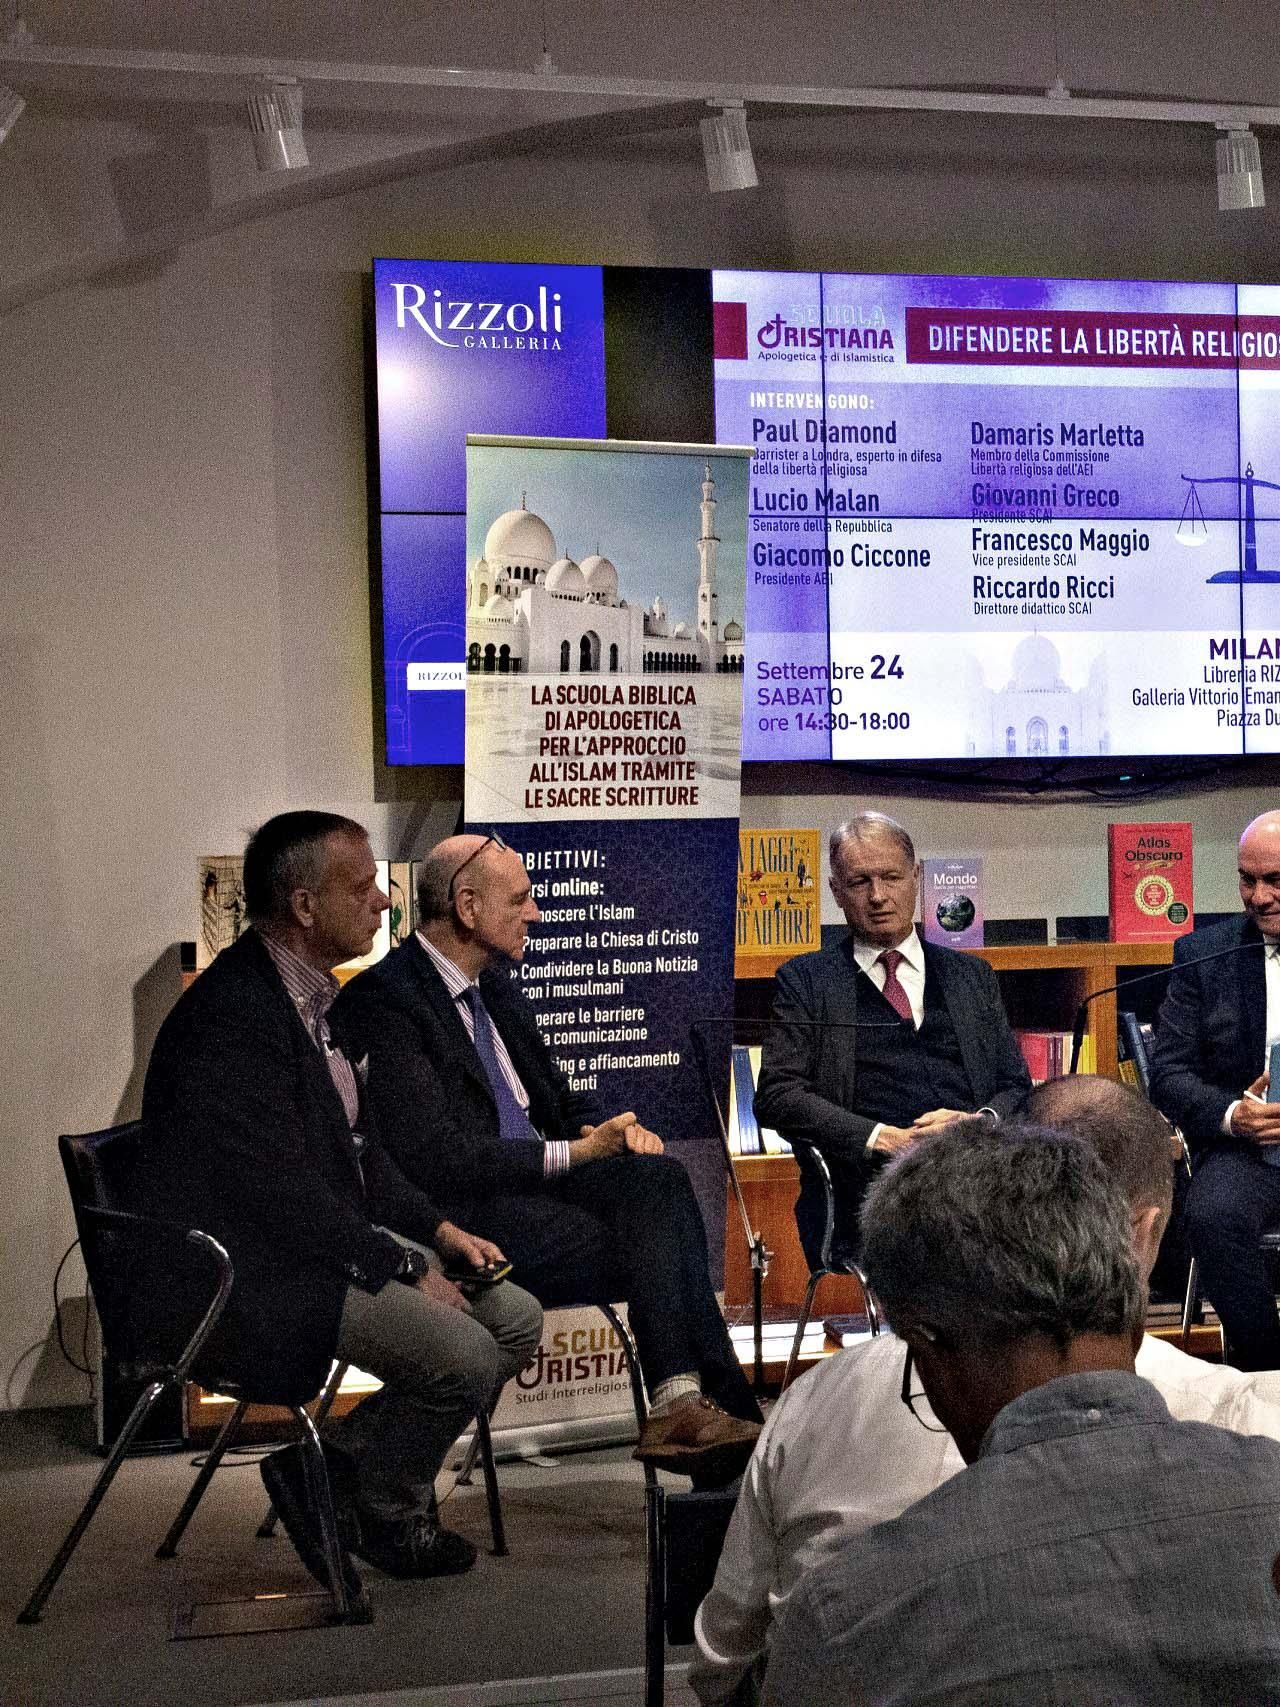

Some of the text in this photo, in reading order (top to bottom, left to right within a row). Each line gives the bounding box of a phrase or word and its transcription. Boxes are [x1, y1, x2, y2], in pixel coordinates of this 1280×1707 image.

[390, 283, 562, 348] Rizzoli
[790, 303, 886, 327] SCUOLA
[463, 335, 562, 350] GALLERIA
[929, 325, 1053, 353] DIFENDERE
[1060, 327, 1089, 354] LA
[1095, 323, 1186, 355] LIBERTÀ
[757, 351, 816, 362] Apologetica
[830, 351, 840, 362] di
[843, 352, 895, 363] Islamistica
[750, 391, 875, 409] INTERVENGONO:
[752, 418, 897, 444] Paul Diamond
[971, 421, 1144, 447] Damaris Marletta
[753, 447, 942, 465] Barrister a Londra, esperto in difesa
[970, 448, 1110, 463] Membro della Commissione
[752, 462, 868, 478] della libertà religiosa
[971, 462, 1093, 479] Libertà religiosa dell'AEI
[753, 487, 880, 512] Lucio Malan
[971, 482, 1120, 508] Giovanni Greco
[972, 508, 1053, 524] Presidente SCAI
[752, 519, 892, 535] Senatore della Repubblica
[972, 527, 1150, 557] Francesco Maggio
[753, 542, 931, 567] Giacomo Ciccone
[972, 553, 1077, 569] Vice presidente SCAI
[754, 571, 833, 585] Presidente AEI
[973, 575, 1115, 599] Riccardo Ricci
[974, 602, 1092, 615] Direttore didattico SCAI
[417, 671, 466, 681] RIZZOL
[757, 654, 905, 680] Settembre 24
[1203, 665, 1257, 683] Libreria
[531, 685, 697, 705] LA SCUOLA BIBLICA
[757, 687, 843, 706] SABATO
[1132, 688, 1185, 706] Galleria
[1188, 687, 1239, 705] Vittorio
[545, 710, 682, 731] DI APOLOGETICA
[758, 712, 910, 731] ore 14:30-18:00
[1217, 709, 1261, 727] Piazza
[539, 736, 686, 757] PER L'APPROCCIO
[529, 761, 696, 783] ALL'ISLAM TRAMITE
[525, 786, 700, 808] LE SACRE SCRITTURE
[1137, 837, 1172, 849] Atlas
[1124, 850, 1183, 862] Obscura
[529, 878, 604, 898] rsi online:
[933, 872, 978, 885] Mondo
[539, 907, 586, 923] noscere
[523, 929, 699, 954] Preparare la Chiesa di Cristo
[521, 956, 698, 980] Condividere la Buona Notizia
[545, 983, 550, 997] i
[552, 979, 624, 998] musulmani
[536, 1006, 645, 1029] perare le barriere
[553, 1026, 648, 1045] comunicazione
[578, 1058, 586, 1071] e
[589, 1051, 680, 1070] affiancamento
[516, 1391, 548, 1405] Studi
